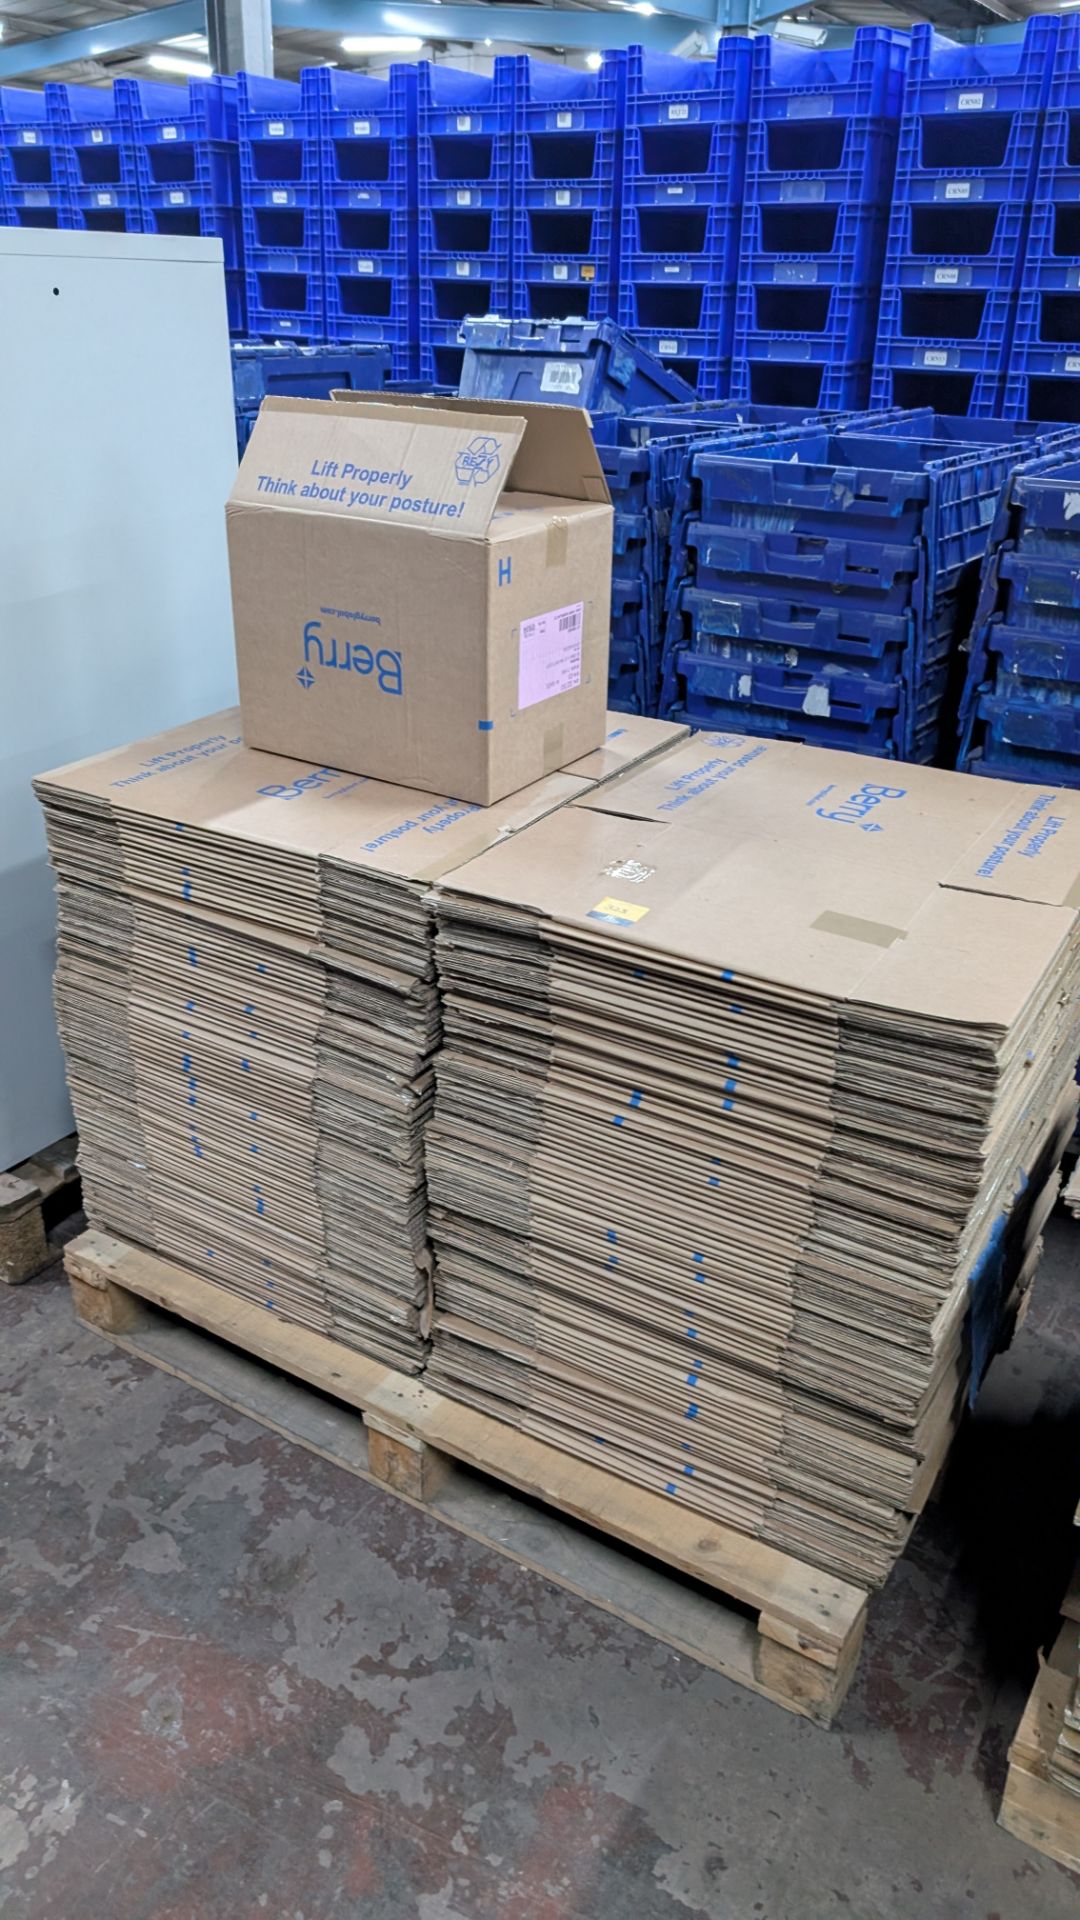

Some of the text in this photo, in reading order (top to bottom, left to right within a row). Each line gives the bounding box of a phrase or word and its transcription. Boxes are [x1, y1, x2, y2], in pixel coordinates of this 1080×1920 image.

[311, 459, 413, 490] Lift Properly
[257, 475, 466, 518] Think about your posture!
[498, 556, 512, 587] H
[303, 620, 402, 696] Berry
[110, 743, 228, 788] Think about your
[139, 754, 167, 768] Lift
[165, 734, 227, 757] Properly
[256, 767, 341, 801] Berr
[656, 794, 693, 811] Think
[687, 778, 717, 796] about
[712, 765, 737, 780] your
[664, 758, 728, 790] Lift Properly
[422, 804, 482, 834] Properly
[816, 783, 907, 824] Berry
[359, 803, 448, 853] your posture!
[975, 794, 1057, 879] Think about your posture!
[1016, 815, 1066, 858] Lift Properly
